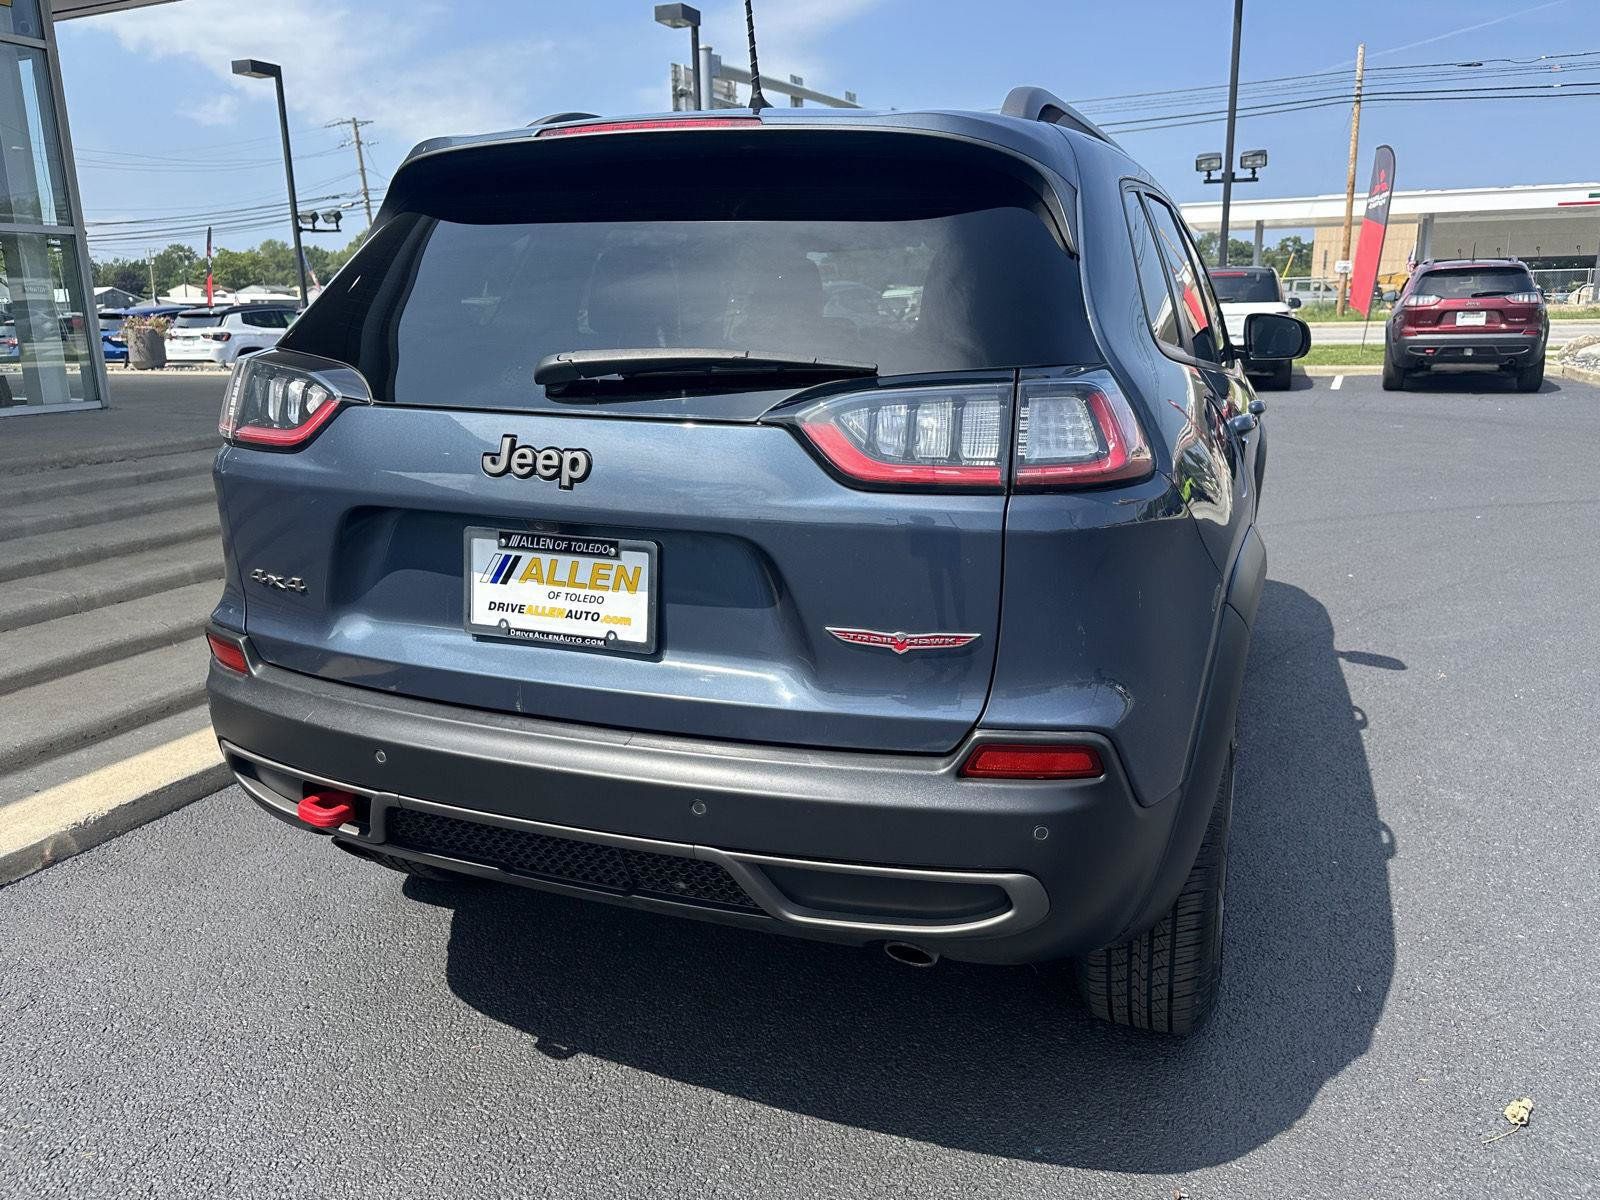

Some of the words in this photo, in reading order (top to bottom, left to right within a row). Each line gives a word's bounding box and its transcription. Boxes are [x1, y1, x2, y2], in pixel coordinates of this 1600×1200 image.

[482, 434, 592, 490] Jeep
[519, 535, 554, 550] ALLEN
[554, 540, 568, 550] OF
[570, 541, 610, 554] TOLEDO
[518, 556, 642, 594] ALLEN
[547, 590, 562, 600] OF
[564, 592, 605, 605] TOLEDO
